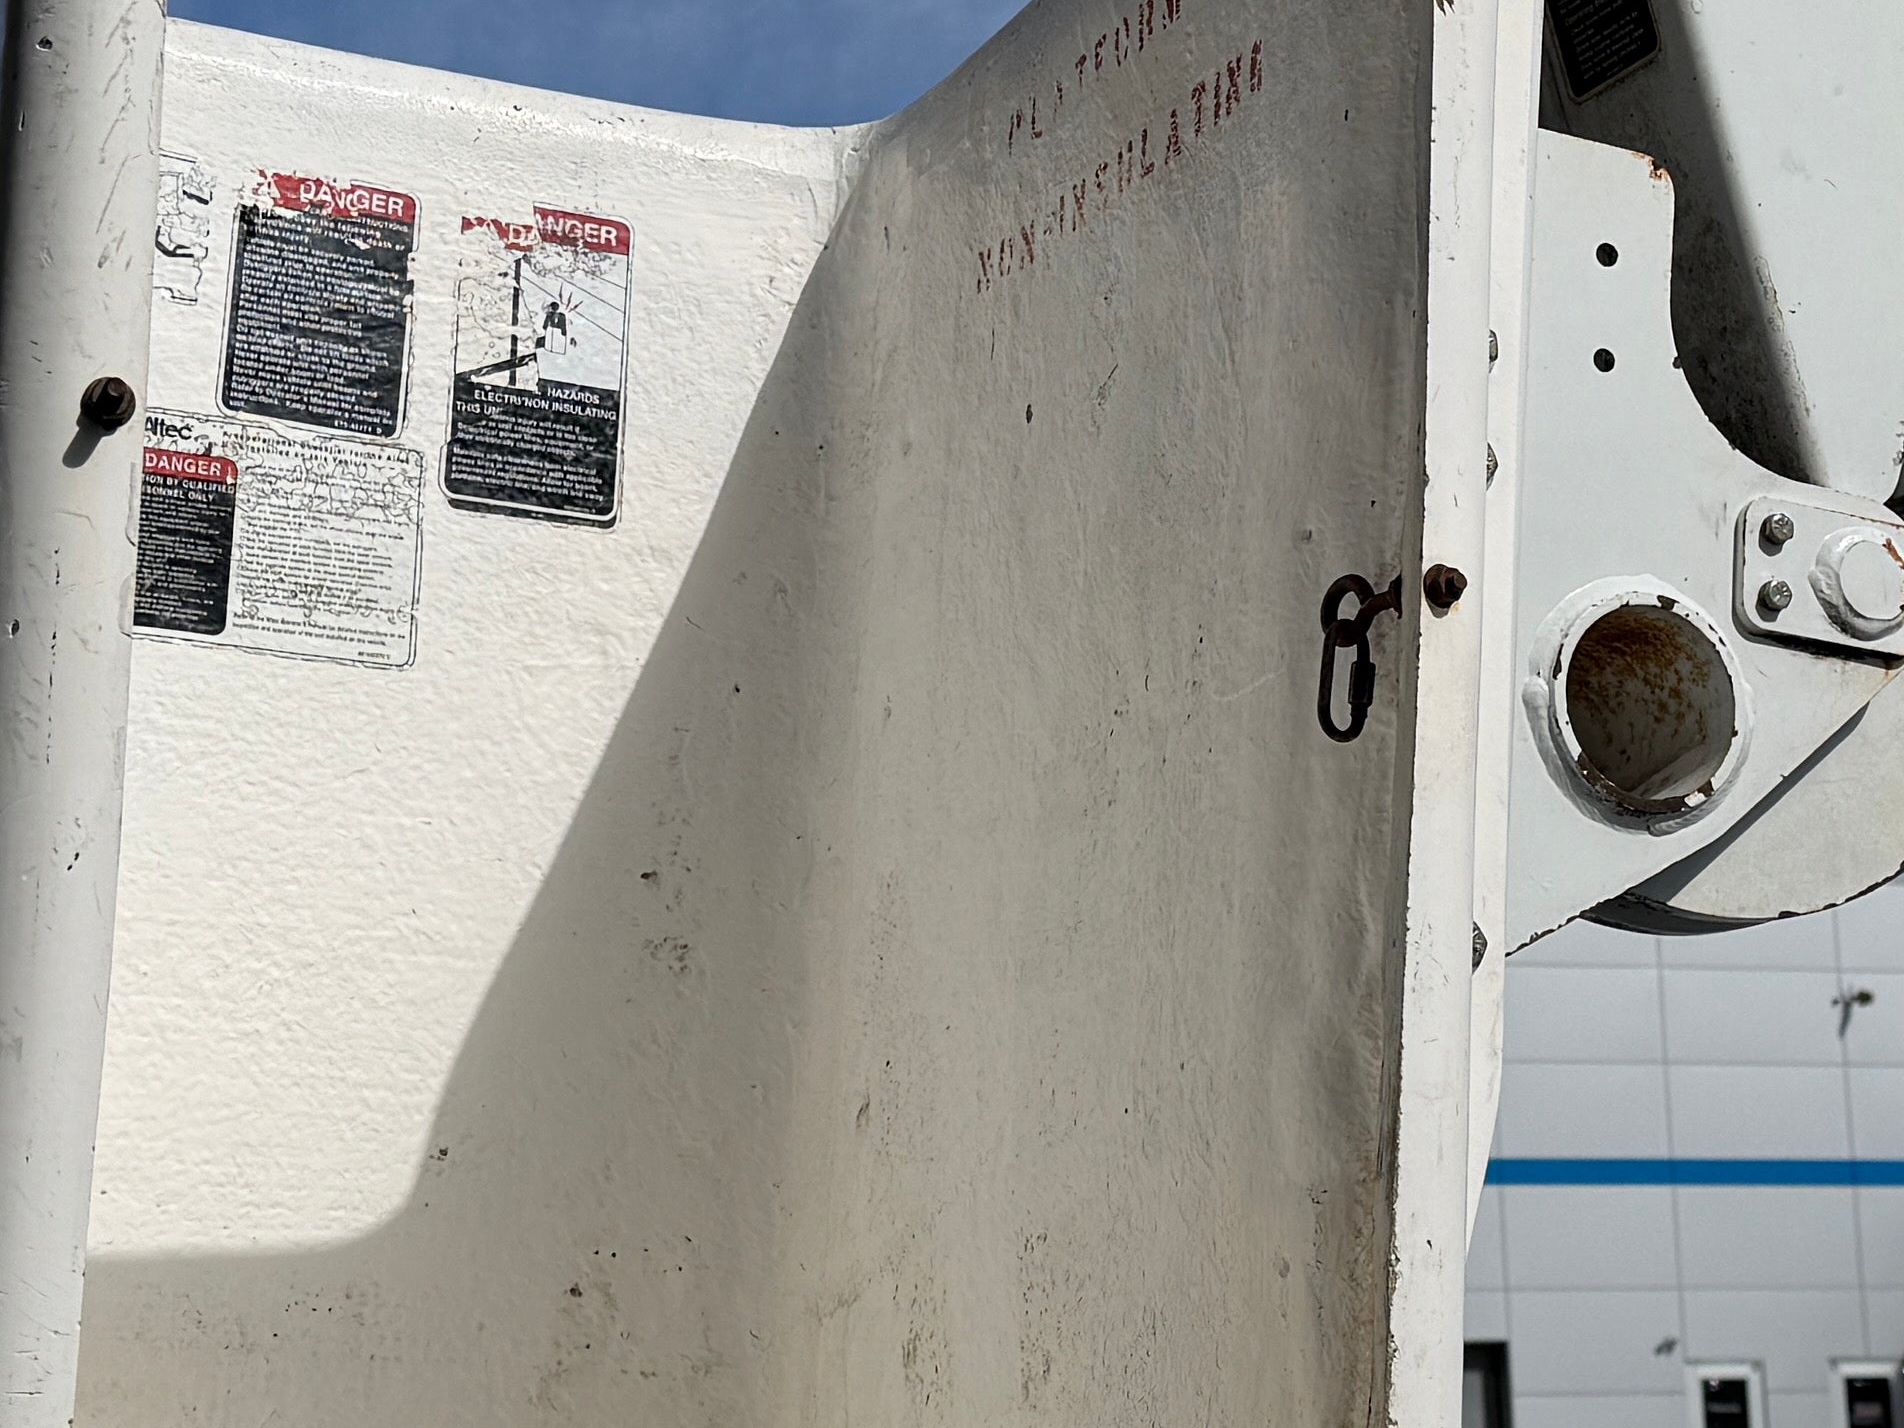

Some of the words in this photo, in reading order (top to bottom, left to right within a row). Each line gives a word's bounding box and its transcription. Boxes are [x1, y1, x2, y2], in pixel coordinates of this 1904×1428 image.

[300, 181, 404, 217] DANGER
[548, 387, 600, 405] HAZARDS
[552, 402, 617, 421] INSULATING
[146, 416, 194, 441] Altec
[146, 452, 222, 478] DANGER
